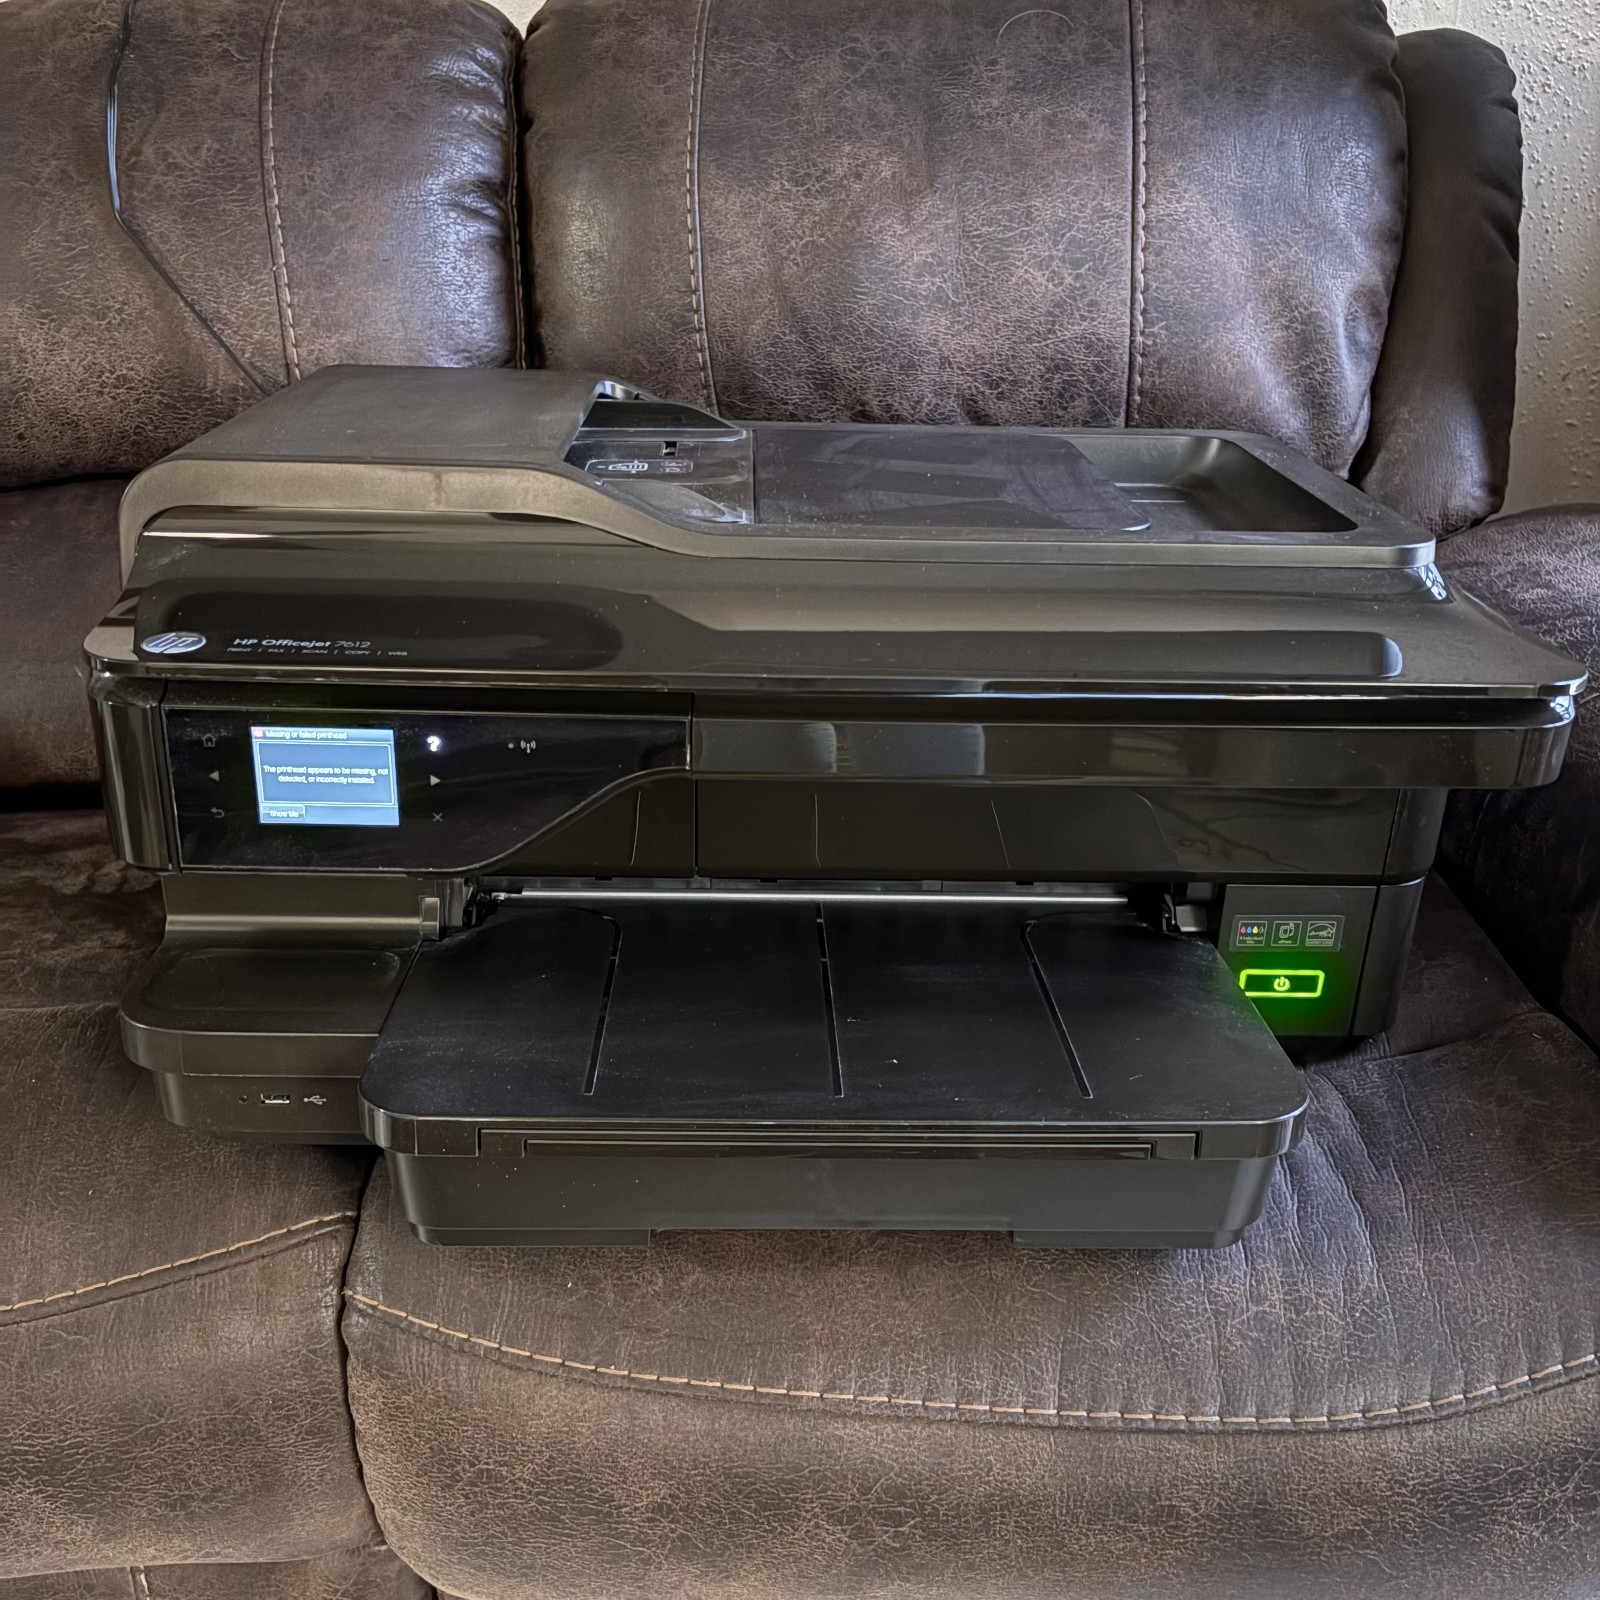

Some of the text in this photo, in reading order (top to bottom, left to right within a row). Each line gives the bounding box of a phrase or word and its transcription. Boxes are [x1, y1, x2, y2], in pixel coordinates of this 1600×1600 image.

[233, 638, 258, 646] HP
[261, 639, 331, 648] Officejet
[265, 730, 291, 739] Missing
[299, 731, 317, 739] failed
[317, 731, 347, 740] printhead
[263, 765, 276, 773] The
[277, 766, 307, 774] printhead
[307, 767, 334, 775] appears
[351, 768, 377, 776] missing,
[316, 776, 347, 784] incorrectly
[270, 810, 287, 818] Show
